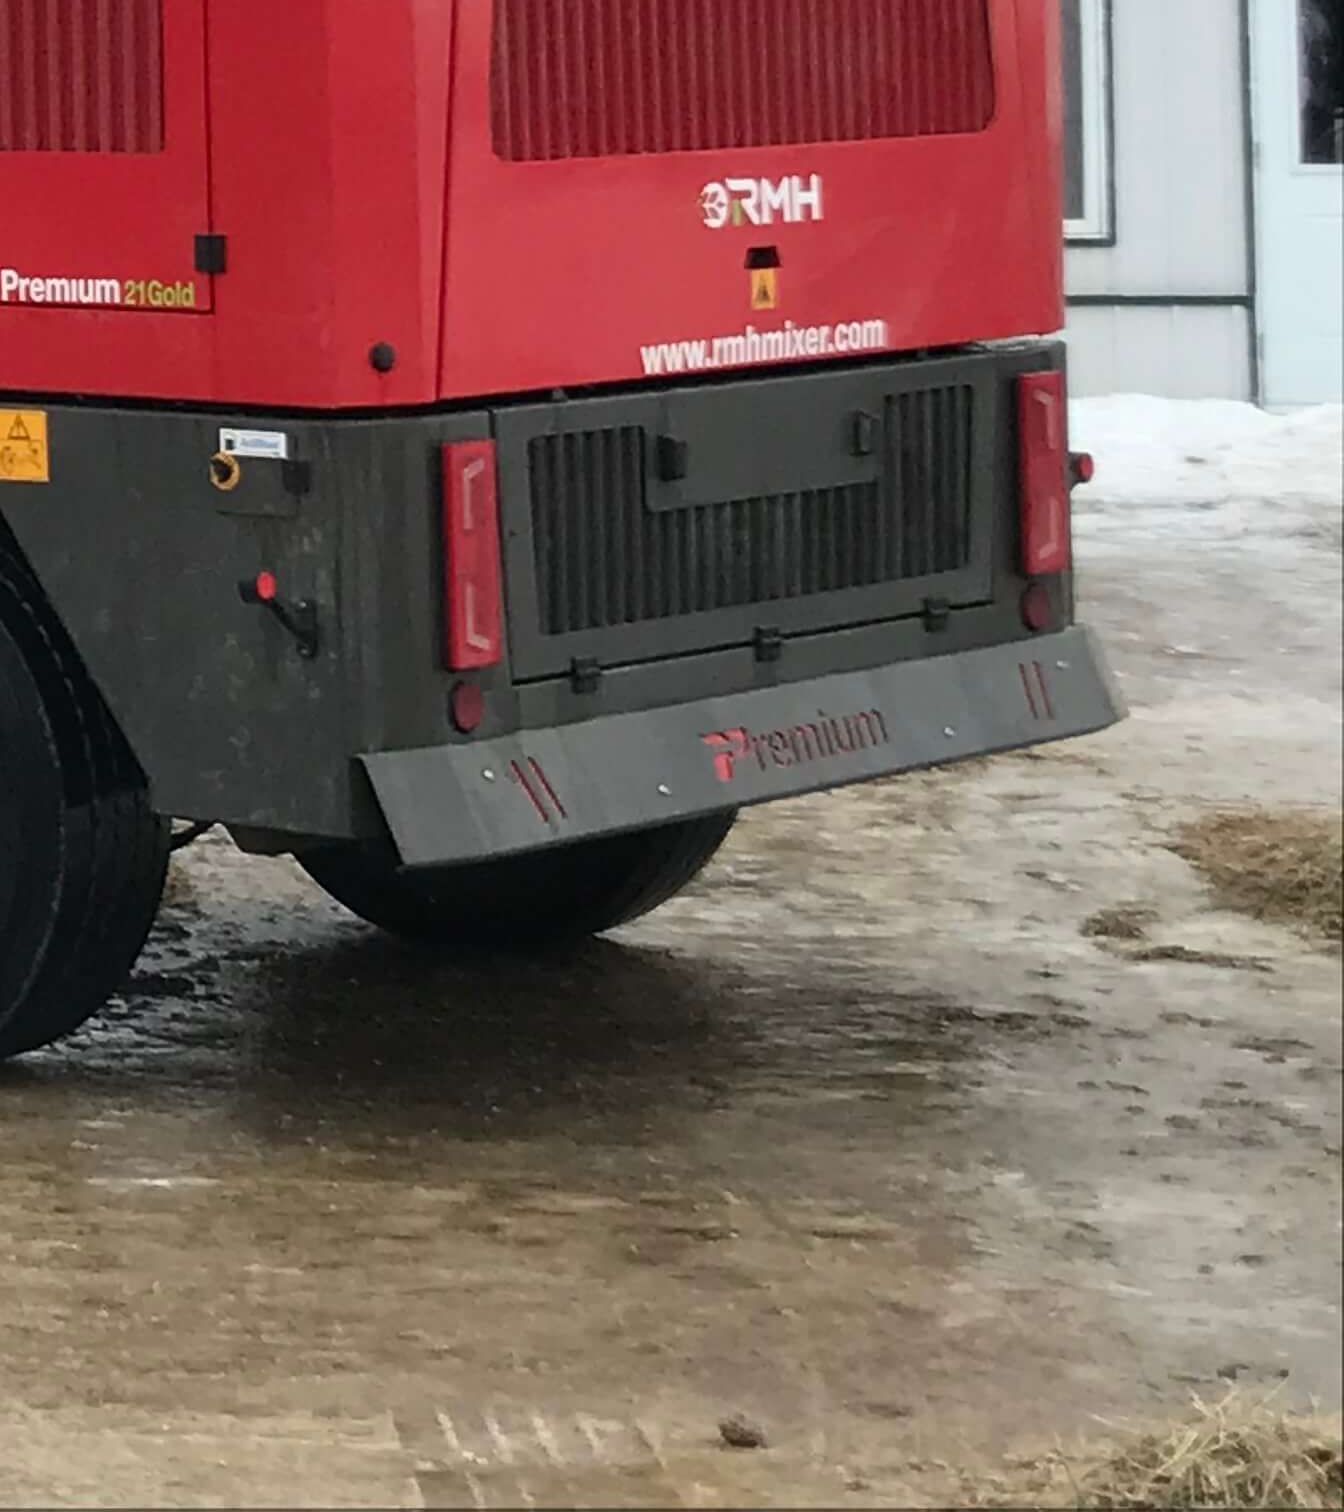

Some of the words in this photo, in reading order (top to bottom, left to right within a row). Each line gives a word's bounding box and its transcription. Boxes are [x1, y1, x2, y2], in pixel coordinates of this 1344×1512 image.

[725, 173, 823, 226] RMH
[0, 268, 121, 304] Premium
[123, 279, 196, 307] 21Gold
[639, 319, 888, 376] www.rmhmixer.com
[698, 708, 889, 784] Premium
